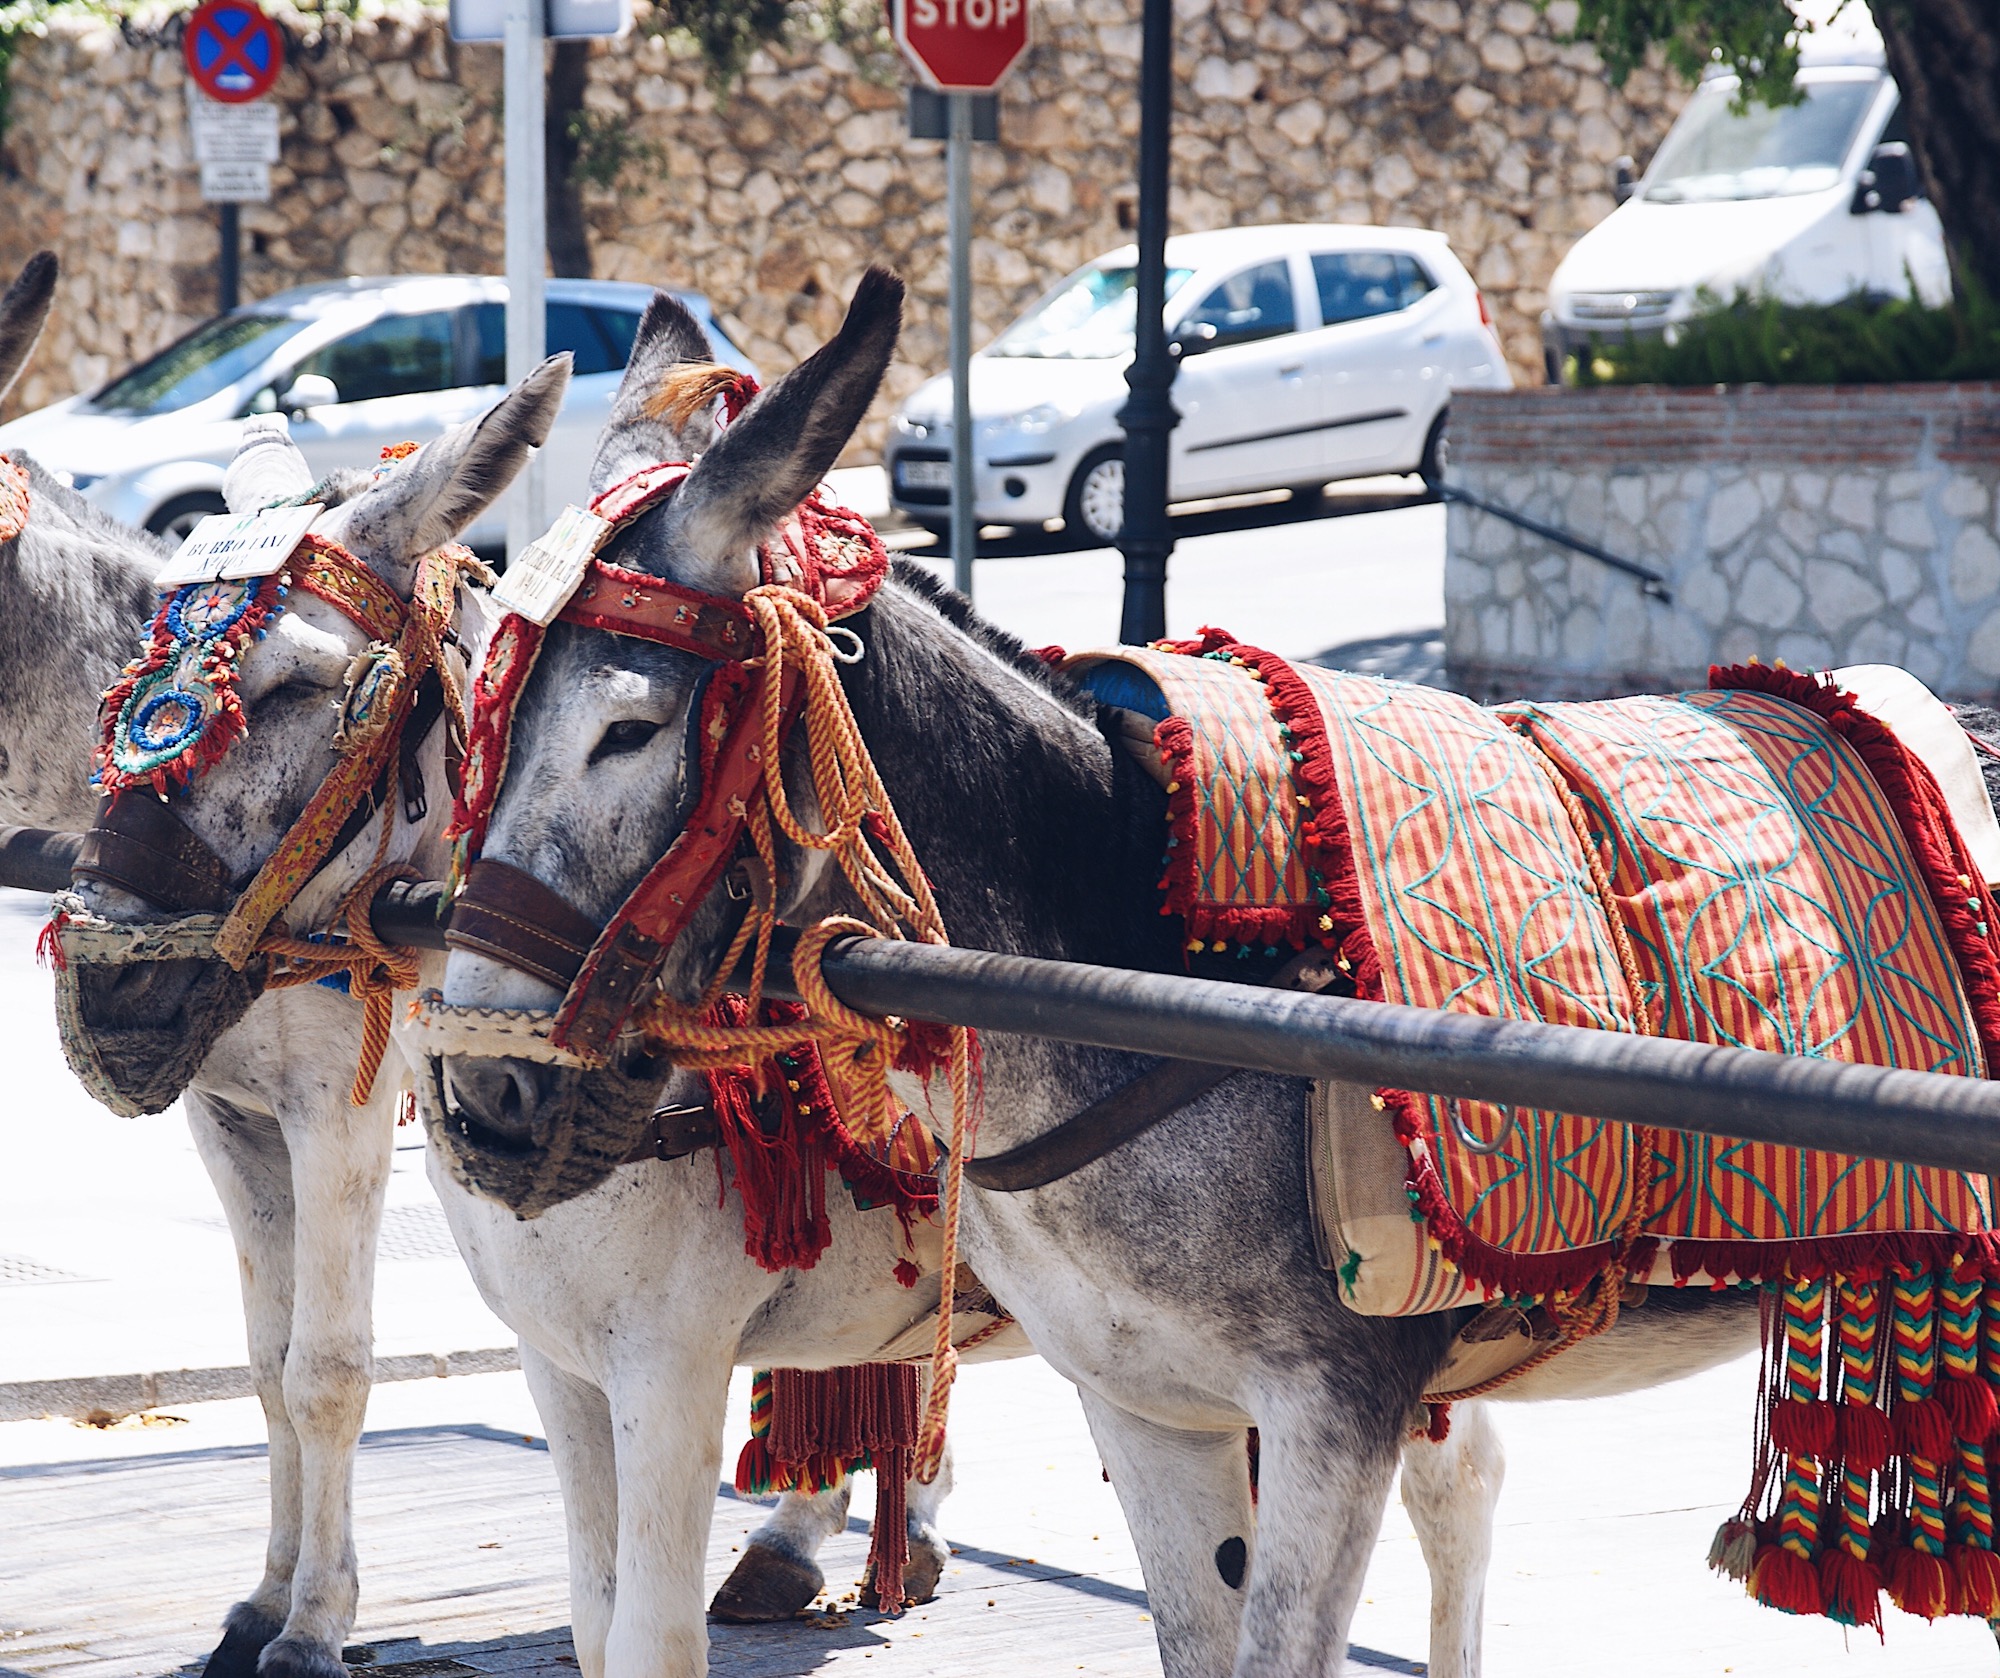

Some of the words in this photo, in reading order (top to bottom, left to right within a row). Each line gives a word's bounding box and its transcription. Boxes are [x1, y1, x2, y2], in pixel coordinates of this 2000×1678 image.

[912, 0, 1021, 29] STOP
[187, 539, 246, 556] BURRO
[249, 534, 287, 550] TAXI
[519, 544, 557, 573] BURRO
